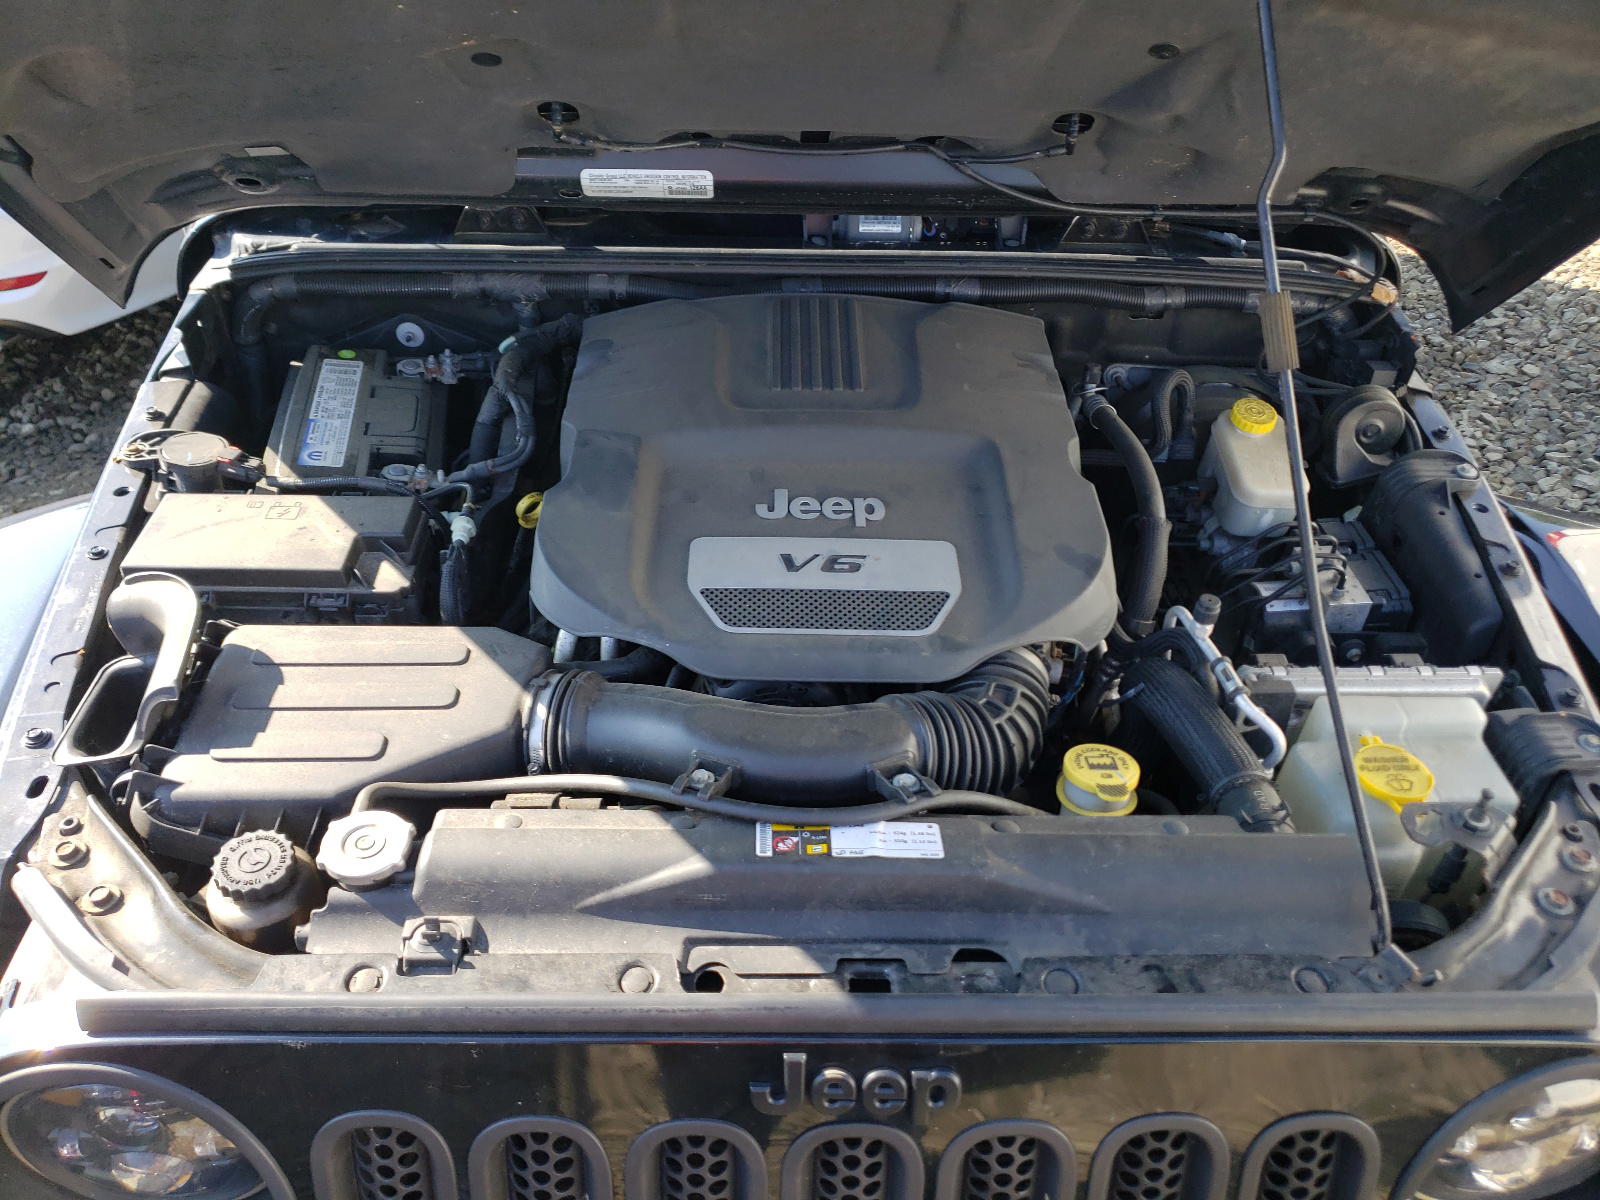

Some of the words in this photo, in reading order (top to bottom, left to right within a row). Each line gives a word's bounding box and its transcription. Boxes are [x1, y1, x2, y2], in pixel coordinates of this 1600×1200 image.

[755, 488, 886, 528] Jeep
[779, 553, 867, 573] V6
[750, 1053, 962, 1129] Jeep
